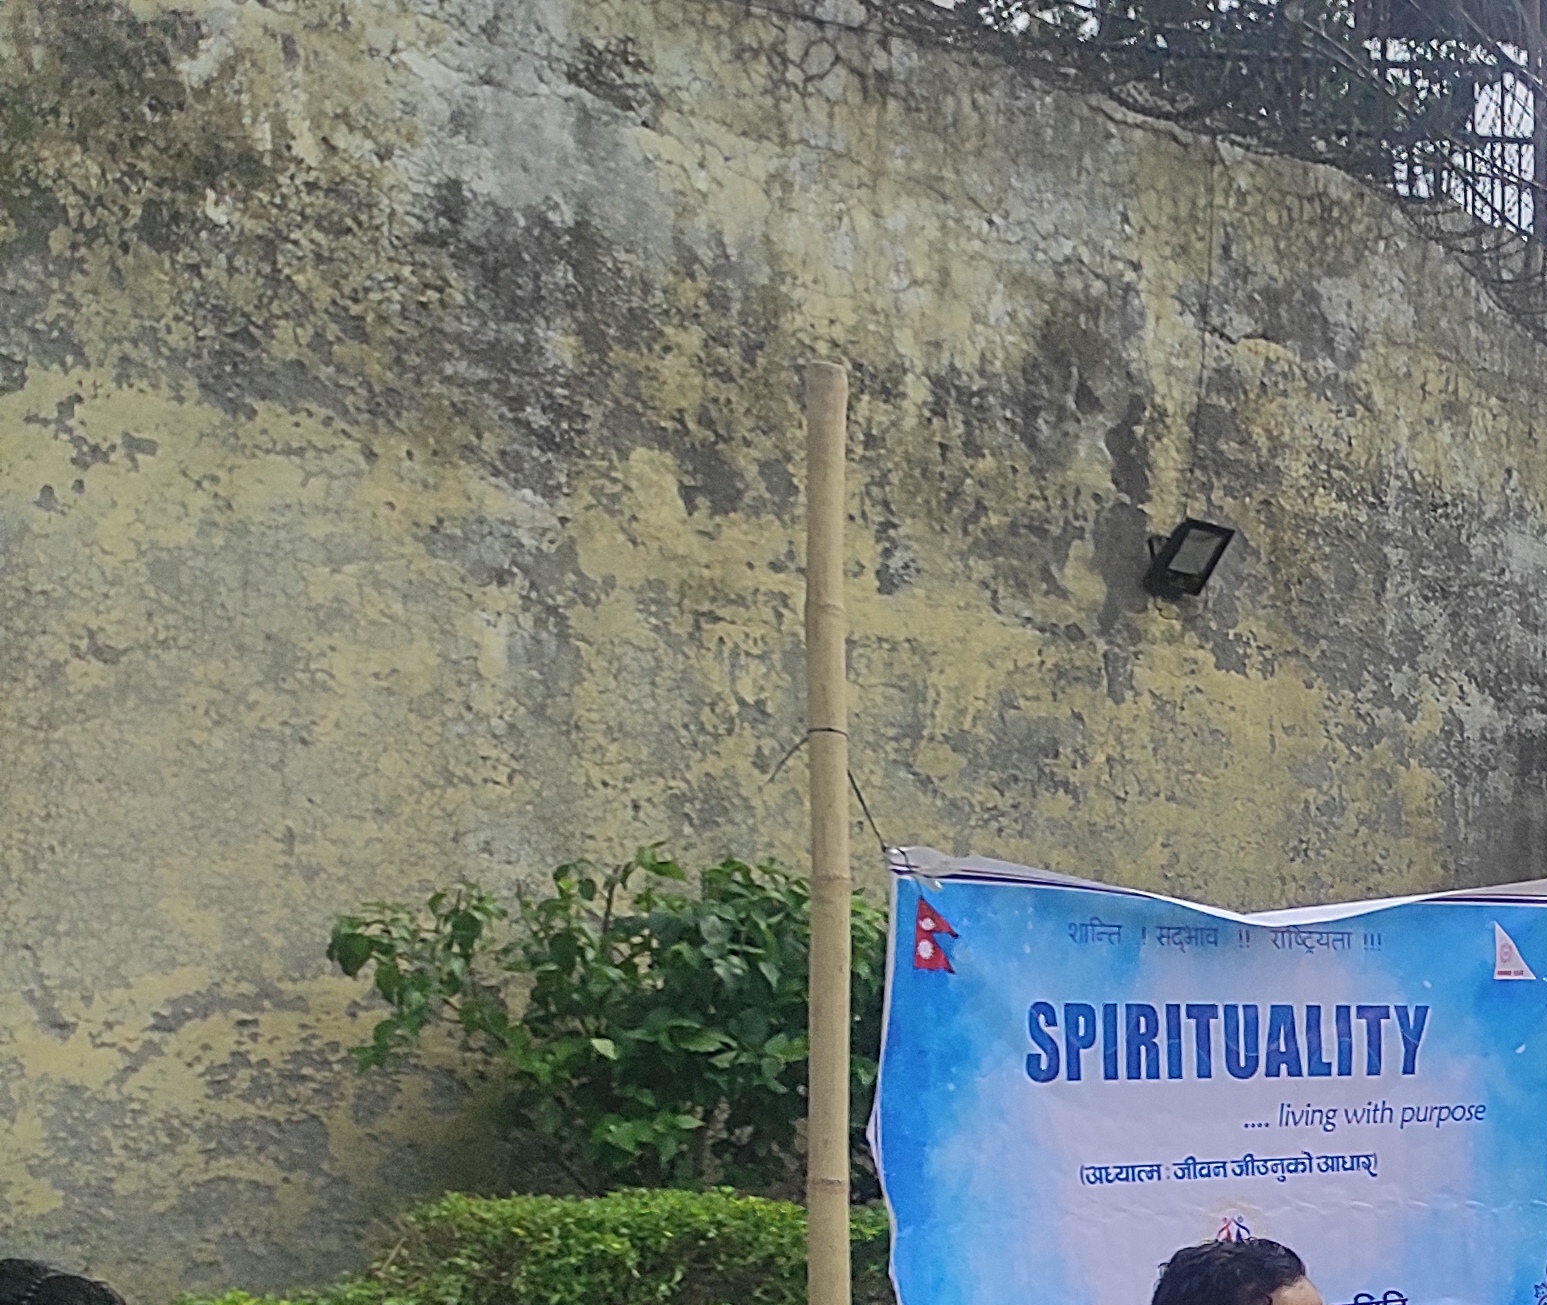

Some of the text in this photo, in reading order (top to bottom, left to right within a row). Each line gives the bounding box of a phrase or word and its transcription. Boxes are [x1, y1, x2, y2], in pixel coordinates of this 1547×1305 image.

[1068, 916, 1123, 944] शान्ति
[1155, 926, 1219, 953] सद्भाव
[1025, 1000, 1430, 1084] SPIRITUALITY
[1278, 1102, 1338, 1133] living
[1343, 1100, 1394, 1125] with
[1399, 1103, 1487, 1130] purpose
[1172, 1156, 1228, 1181] जीवन
